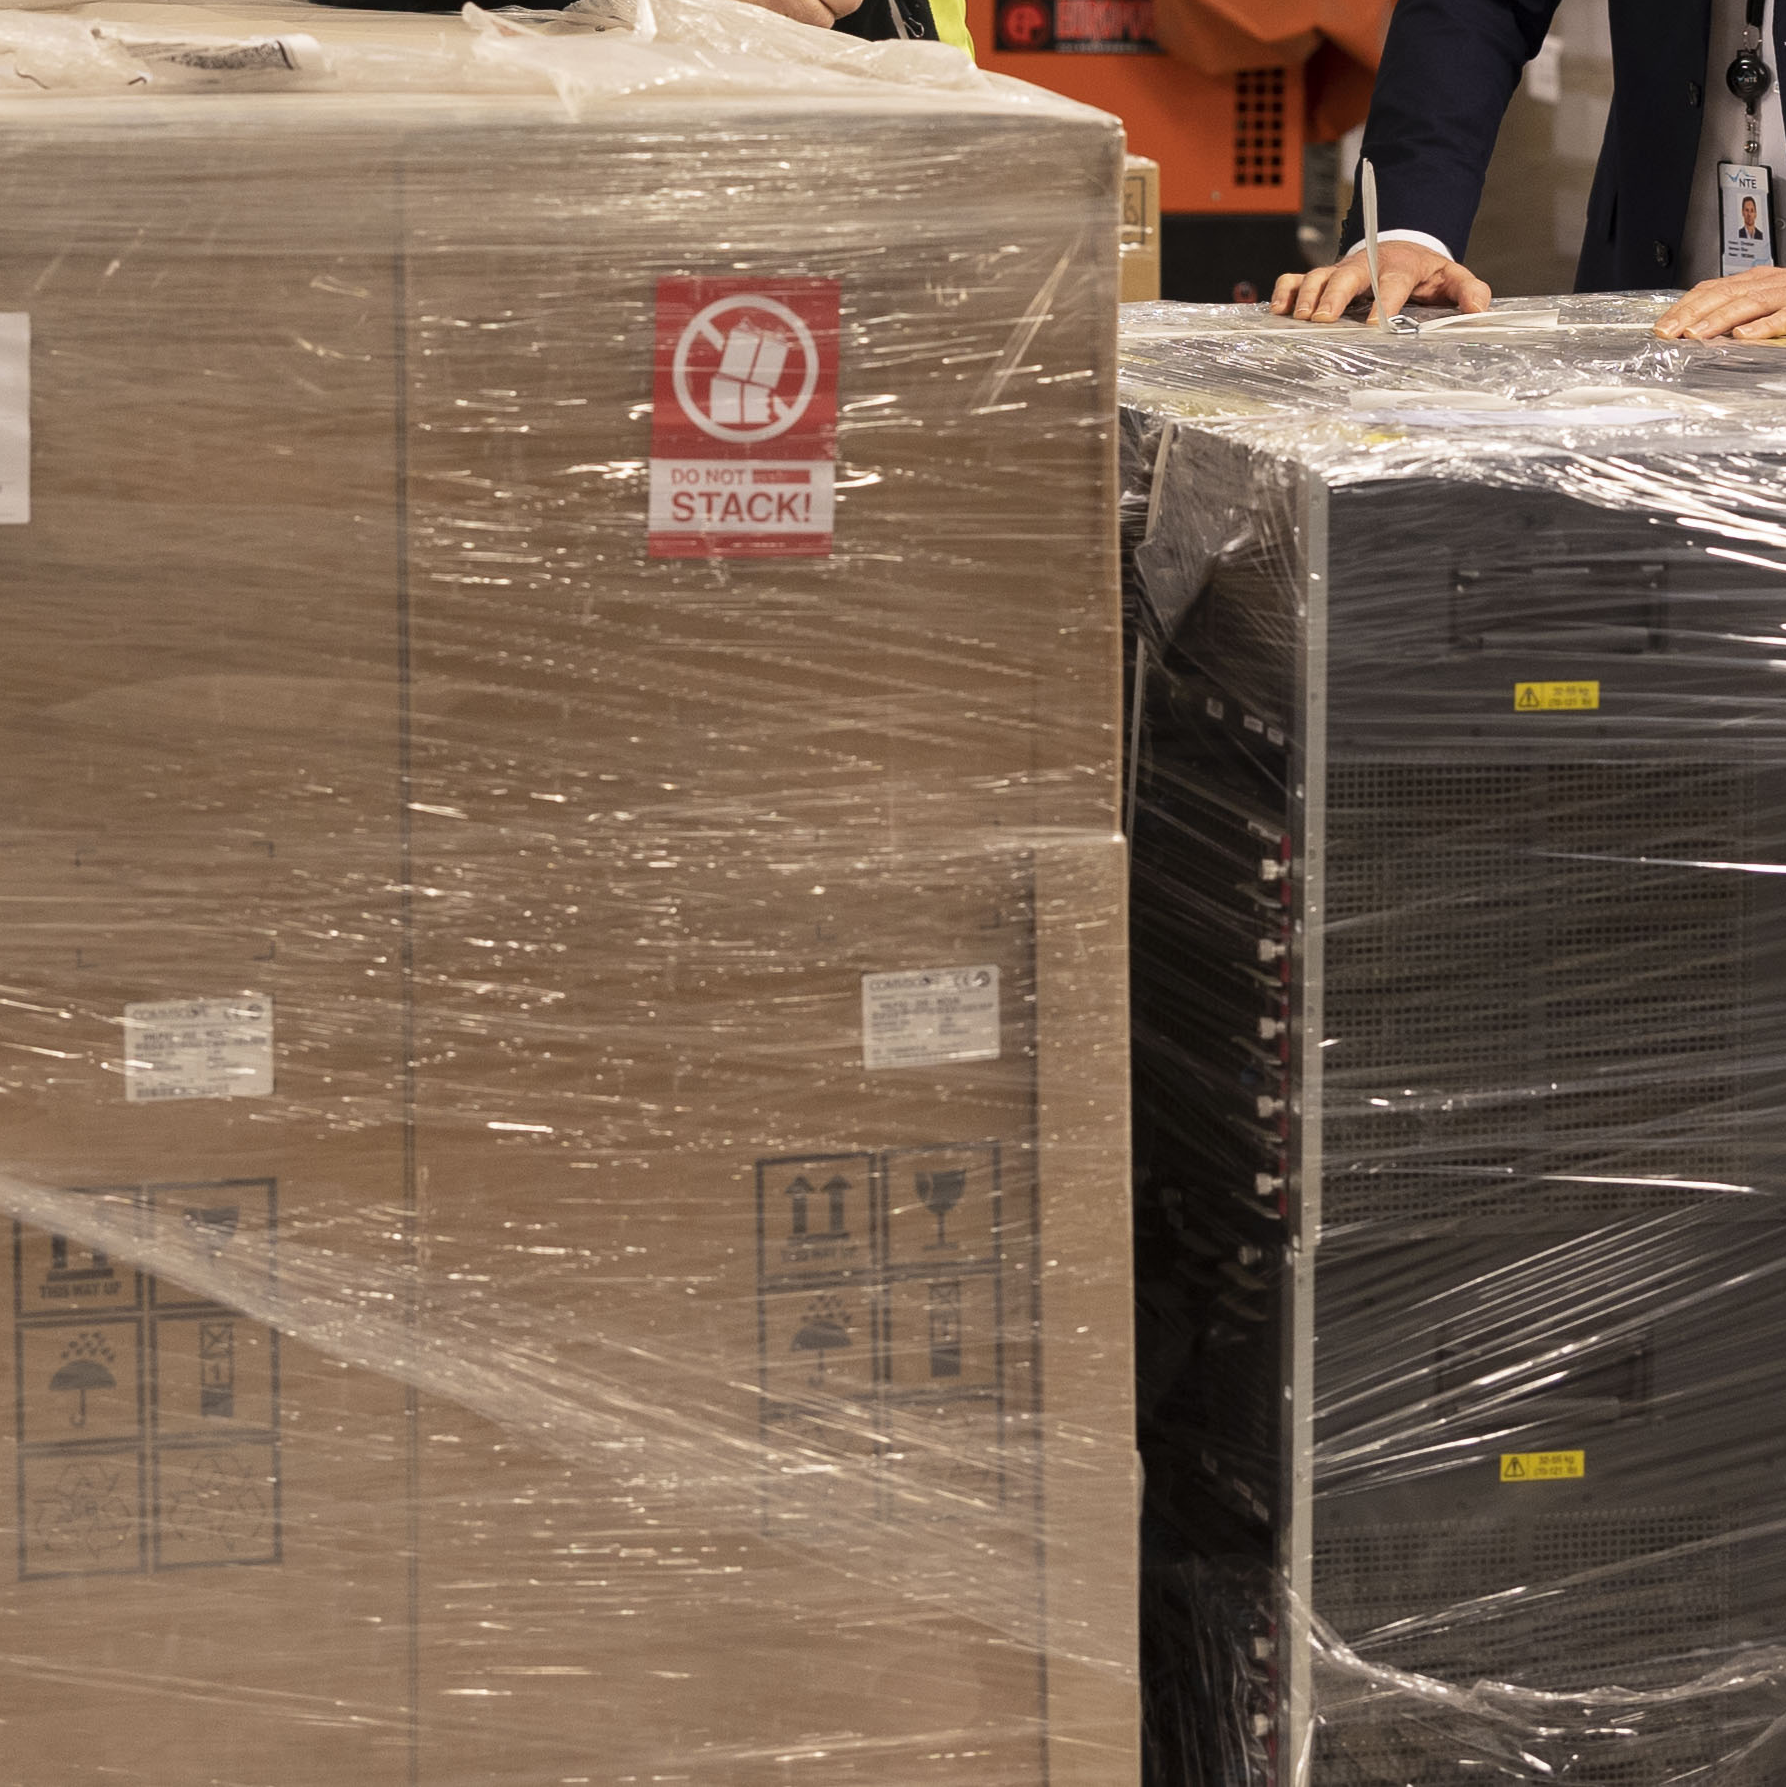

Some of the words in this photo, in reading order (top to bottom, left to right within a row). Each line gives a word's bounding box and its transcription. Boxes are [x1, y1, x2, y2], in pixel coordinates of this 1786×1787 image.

[1739, 178, 1757, 189] NTE
[671, 468, 700, 486] DO
[705, 468, 746, 486] NOT
[671, 491, 812, 523] STACK!
